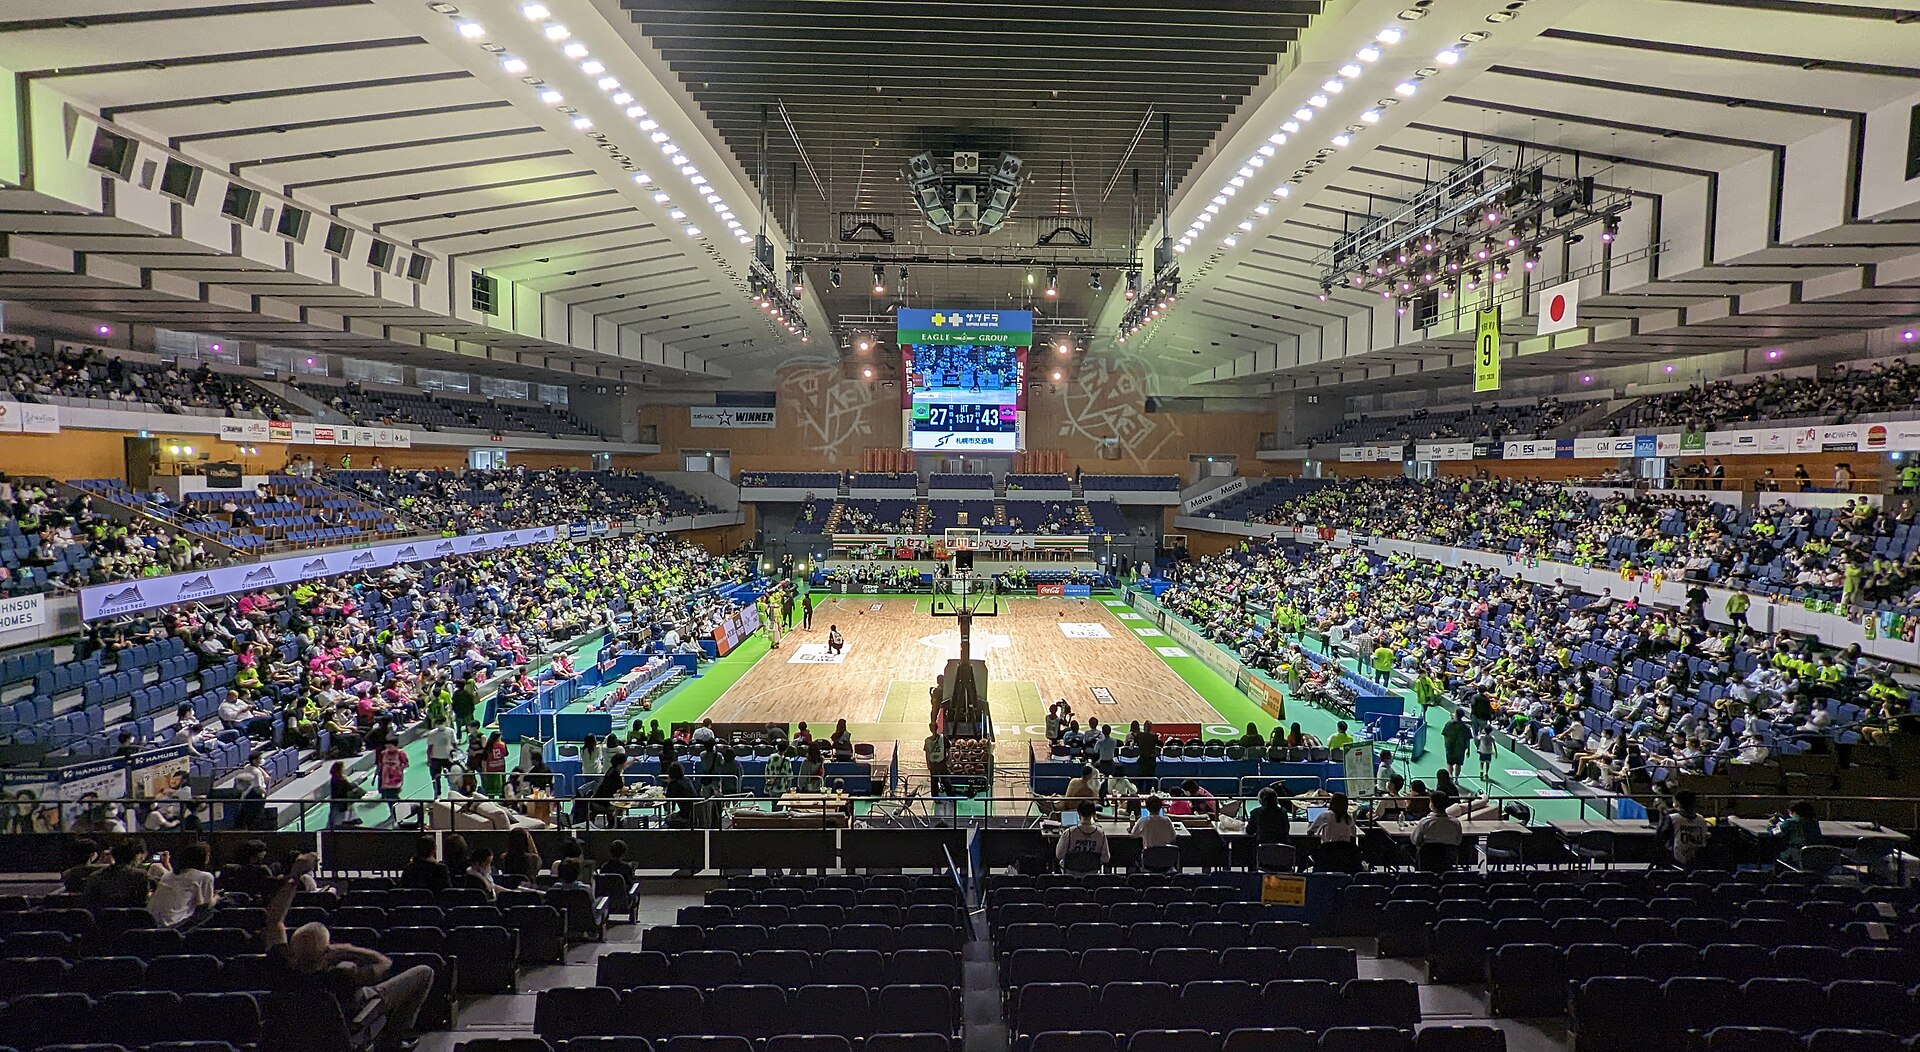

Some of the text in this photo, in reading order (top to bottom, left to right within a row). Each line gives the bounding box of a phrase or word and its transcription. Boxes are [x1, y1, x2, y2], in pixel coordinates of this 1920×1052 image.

[966, 313, 999, 322] サツドラ
[921, 333, 1008, 342] EAGLE GROUP
[1483, 334, 1492, 367] 9
[960, 405, 969, 413] HT
[735, 412, 774, 422] WINNER
[929, 408, 947, 425] 27
[955, 414, 974, 423] 13:17
[981, 409, 999, 426] 43
[1597, 442, 1609, 451] GM
[1220, 481, 1242, 495] Motto
[1190, 495, 1213, 508] Motto
[242, 580, 264, 589] Diamond
[177, 588, 217, 601] Diamond head
[98, 601, 147, 616] Diamond head
[146, 750, 179, 762] HAMURE
[493, 748, 501, 759] 12
[76, 764, 114, 775] HAMURE
